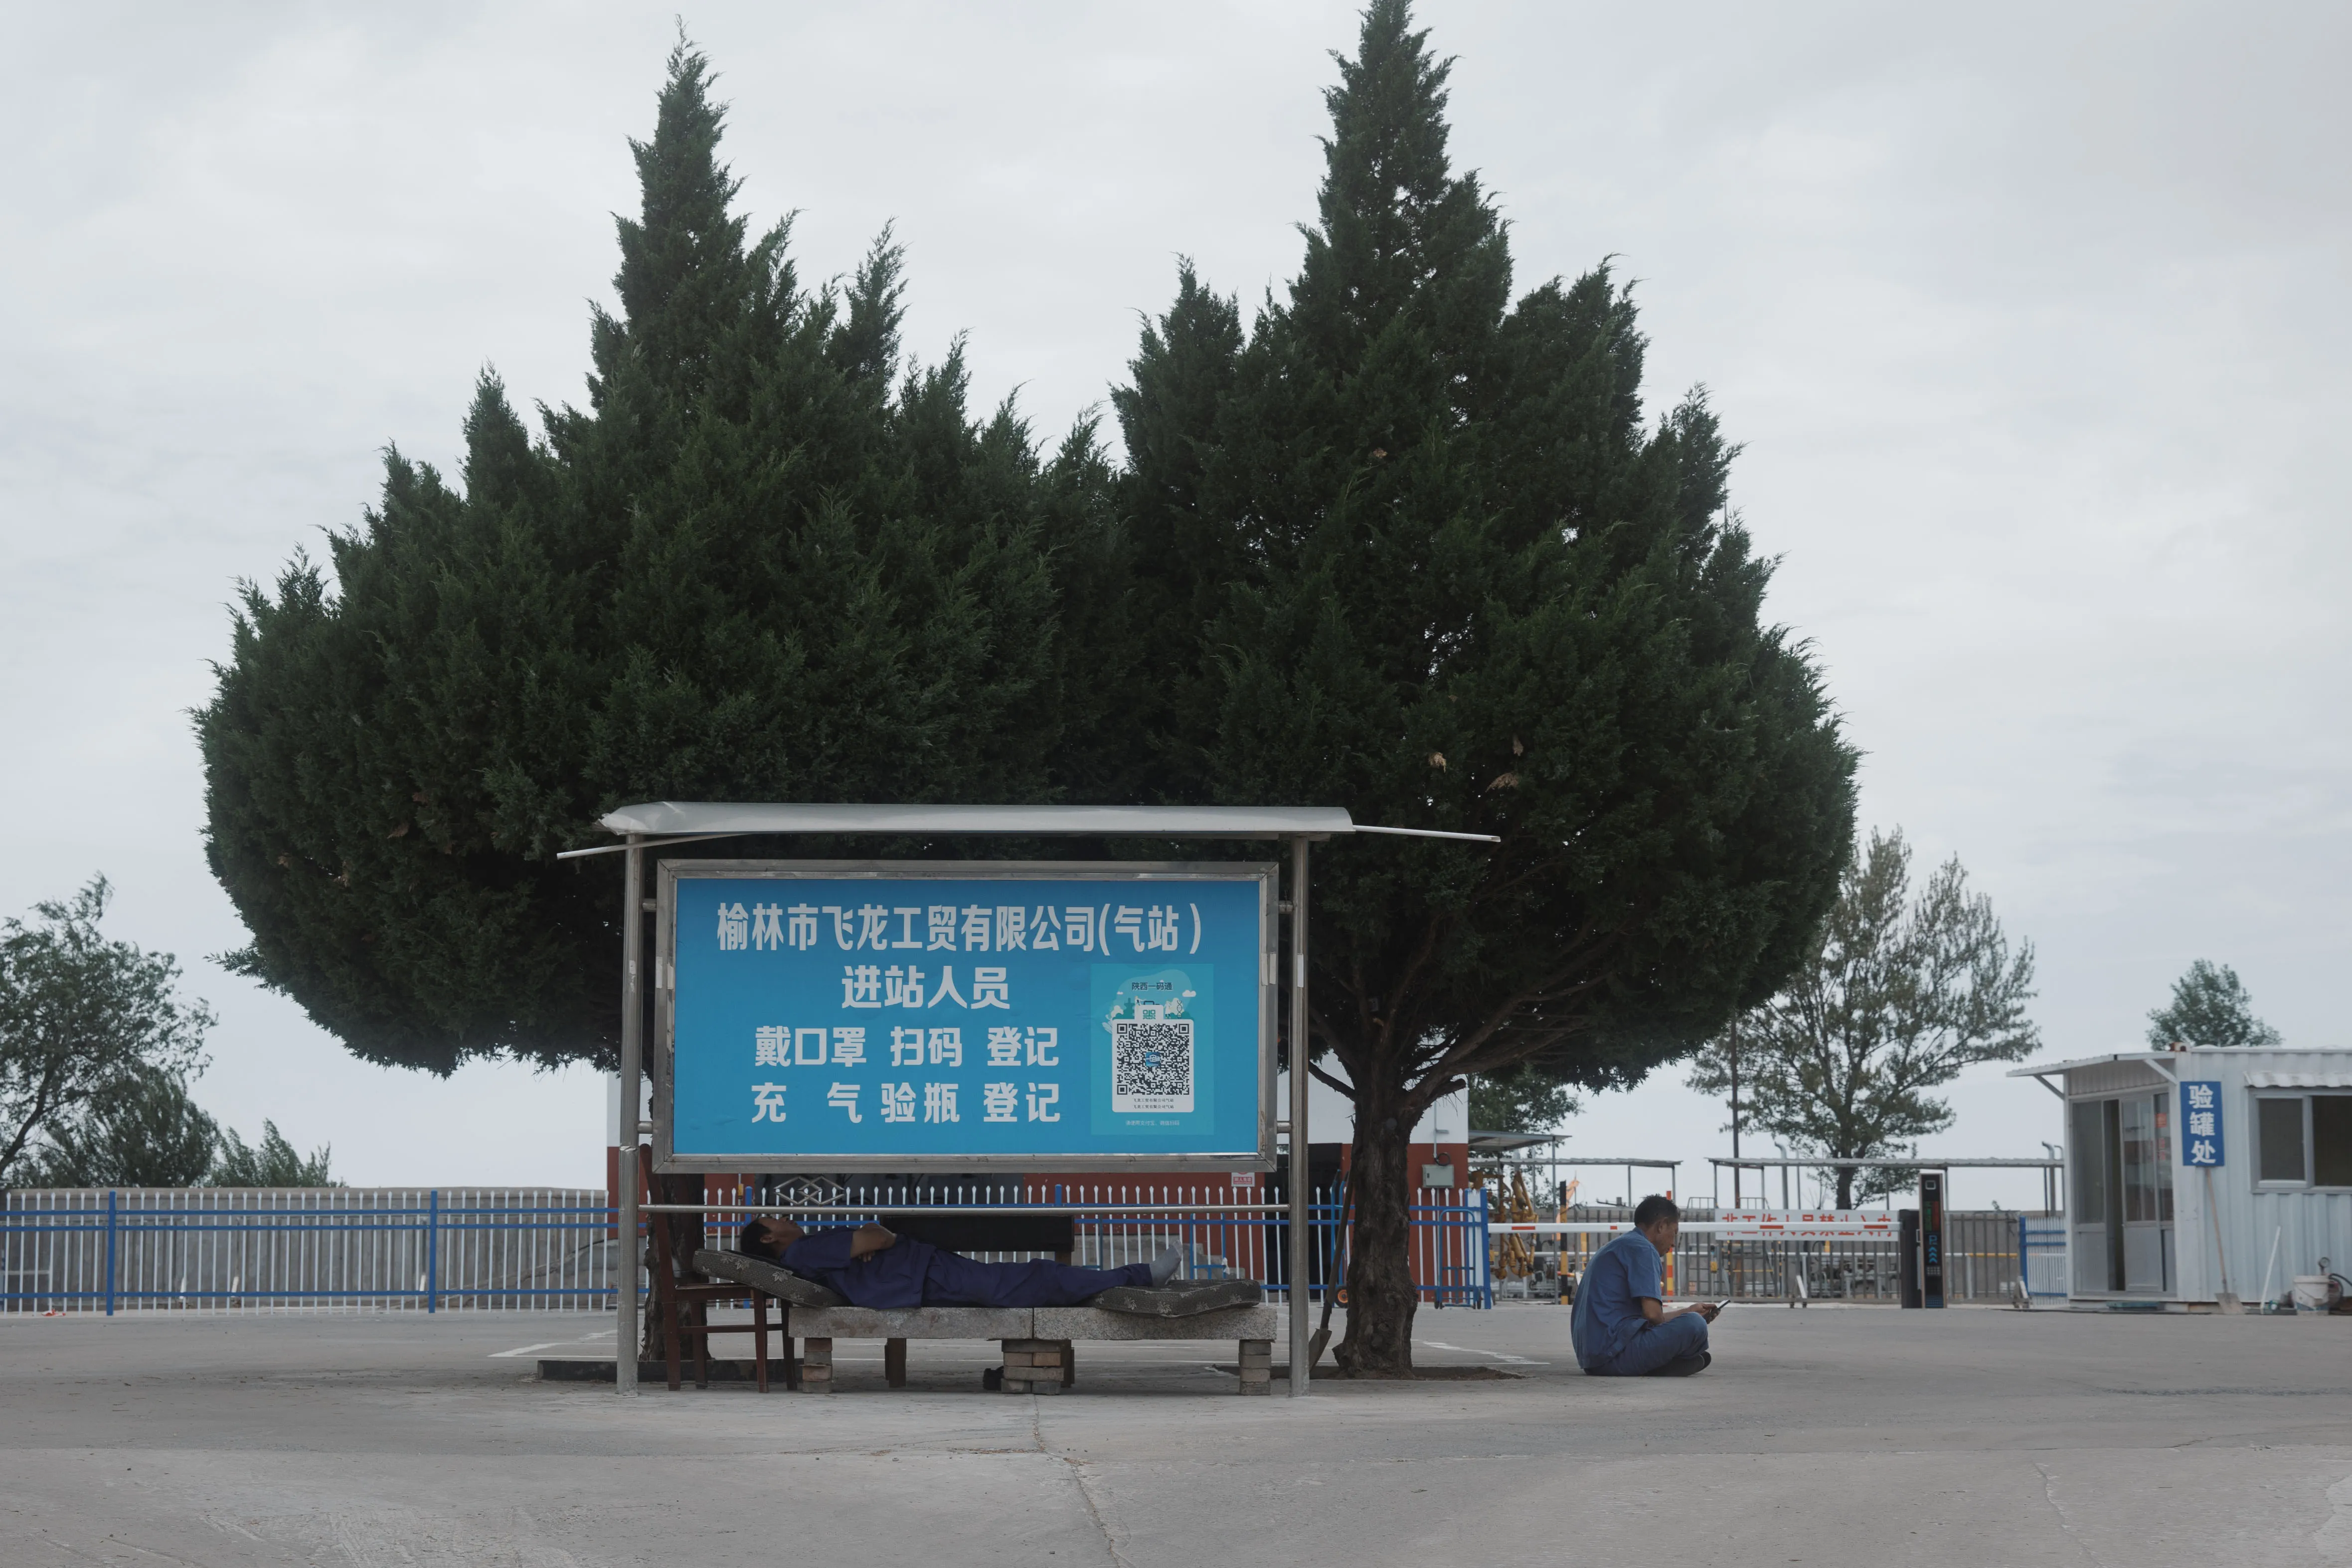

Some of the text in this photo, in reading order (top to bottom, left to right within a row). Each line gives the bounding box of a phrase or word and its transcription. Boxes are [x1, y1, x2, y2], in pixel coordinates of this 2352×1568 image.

[841, 965, 1010, 1009] 进站人员
[1132, 982, 1173, 991] 陕西一码通
[755, 1026, 1059, 1067] 戴口罩 扫码 登记
[881, 1082, 960, 1124] 验瓶
[984, 1082, 1060, 1122] 登记
[2188, 1084, 2216, 1164] 验罐处
